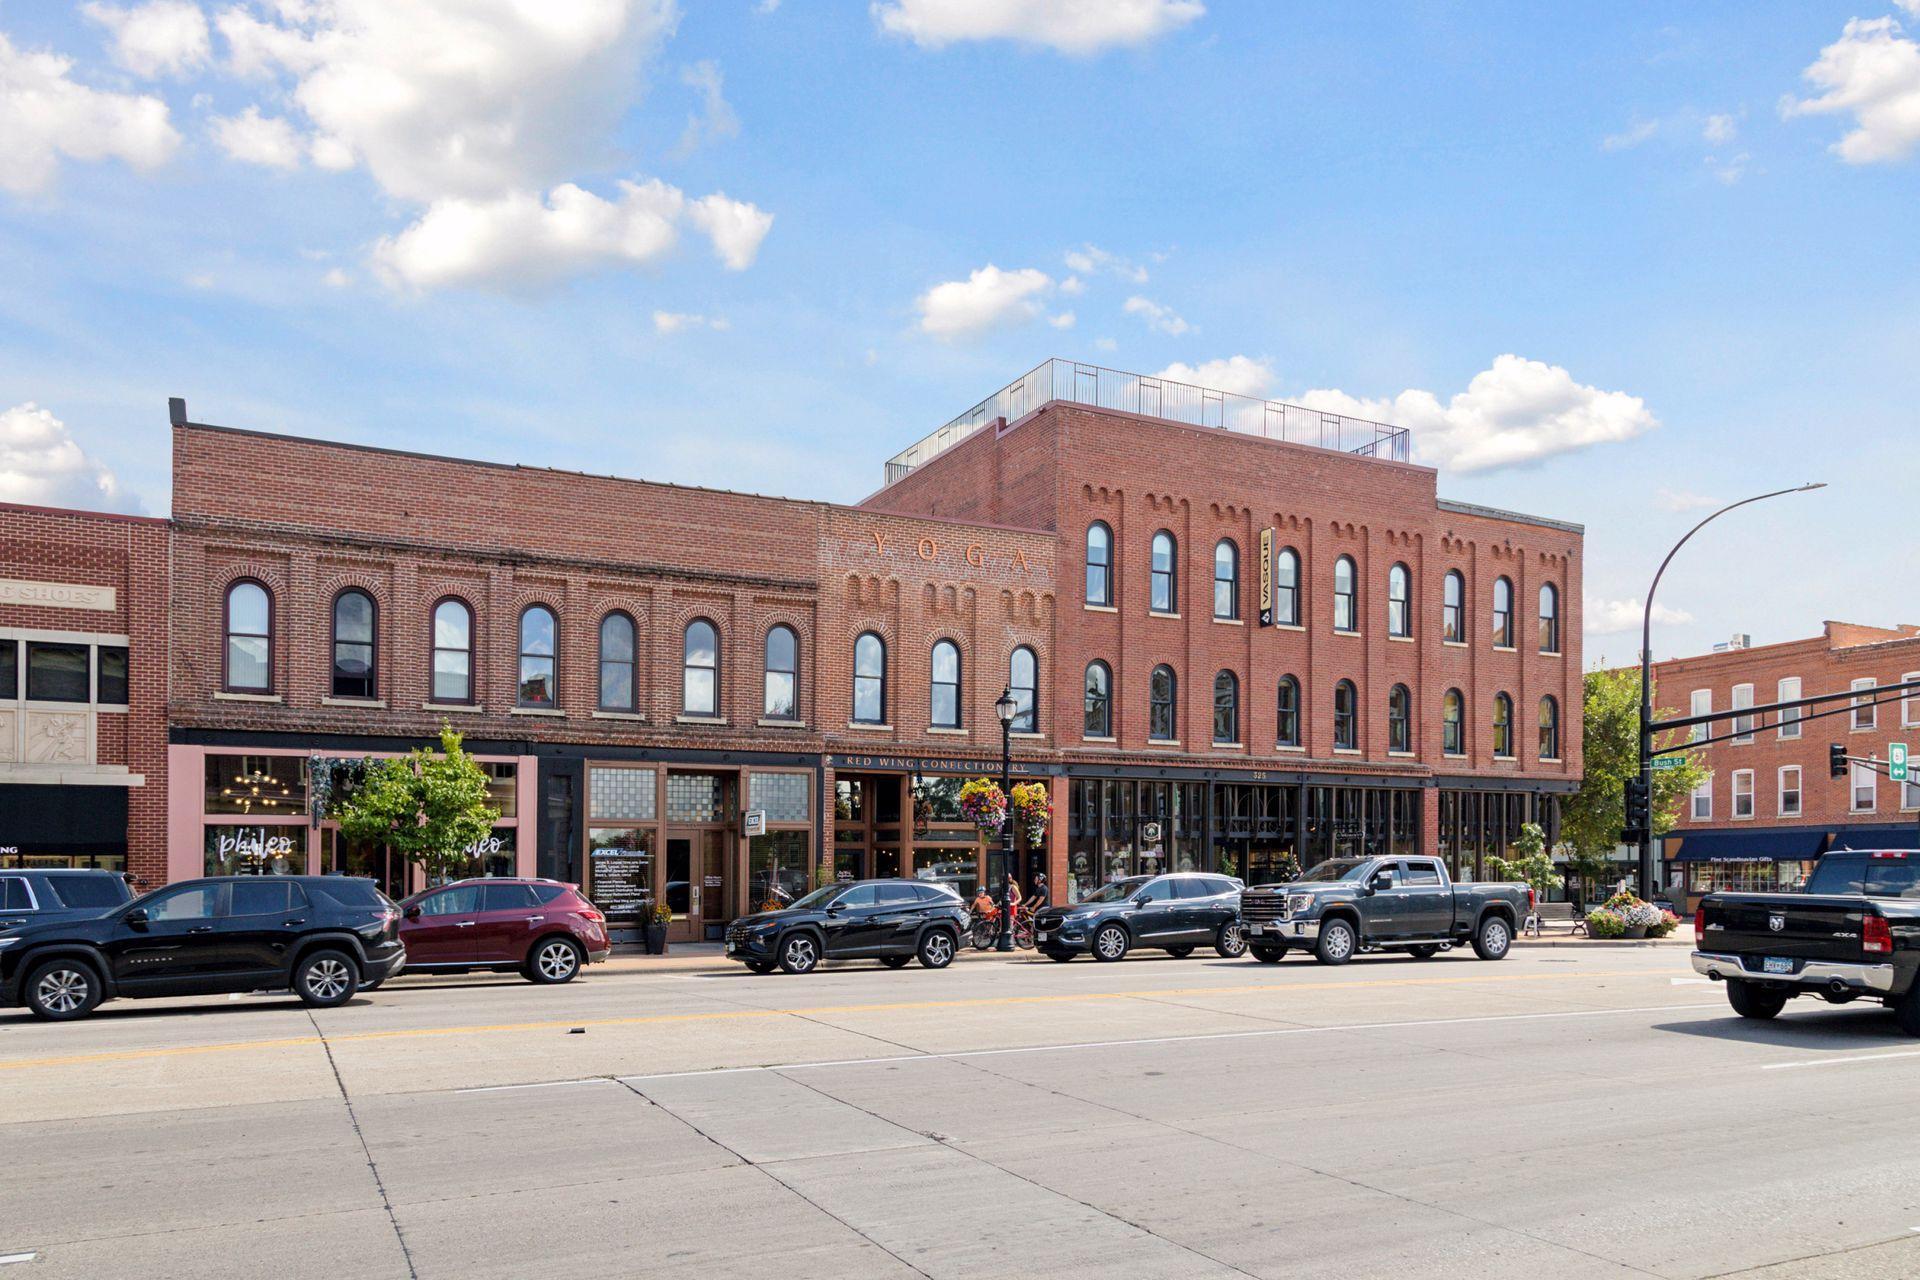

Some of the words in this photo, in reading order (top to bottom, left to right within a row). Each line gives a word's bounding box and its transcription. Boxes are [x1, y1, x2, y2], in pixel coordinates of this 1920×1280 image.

[874, 532, 1030, 573] YOGA
[19, 587, 100, 605] SHOES
[847, 756, 871, 766] RED
[880, 758, 914, 768] WING
[921, 759, 1026, 772] CONFECTIONRY
